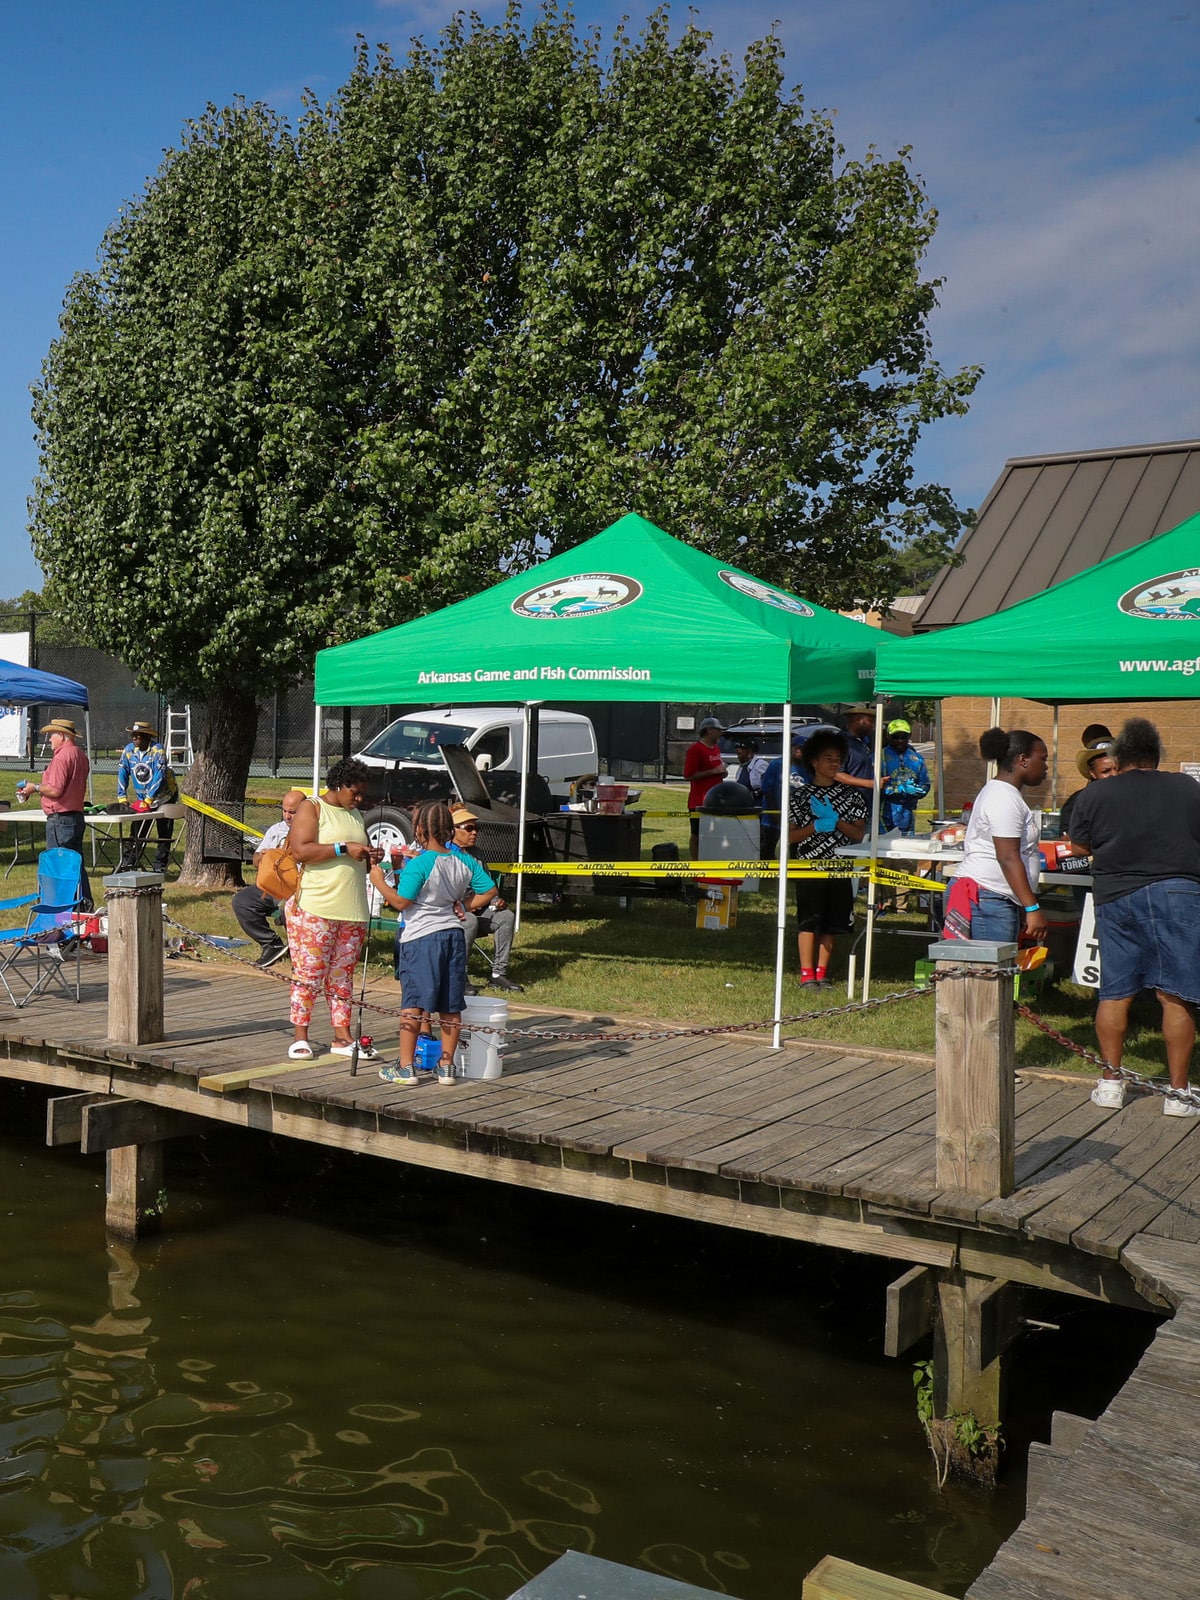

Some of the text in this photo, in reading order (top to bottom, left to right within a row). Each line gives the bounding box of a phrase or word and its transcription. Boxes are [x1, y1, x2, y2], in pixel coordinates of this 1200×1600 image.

[417, 666, 650, 684] Arkansas Game and Fish Commission
[804, 836, 837, 860] HUSTLE
[650, 862, 690, 870] CAUTION
[727, 861, 770, 870] CAUTION
[1061, 858, 1089, 871] FORKS
[1086, 943, 1100, 962] T
[1082, 965, 1100, 984] S
